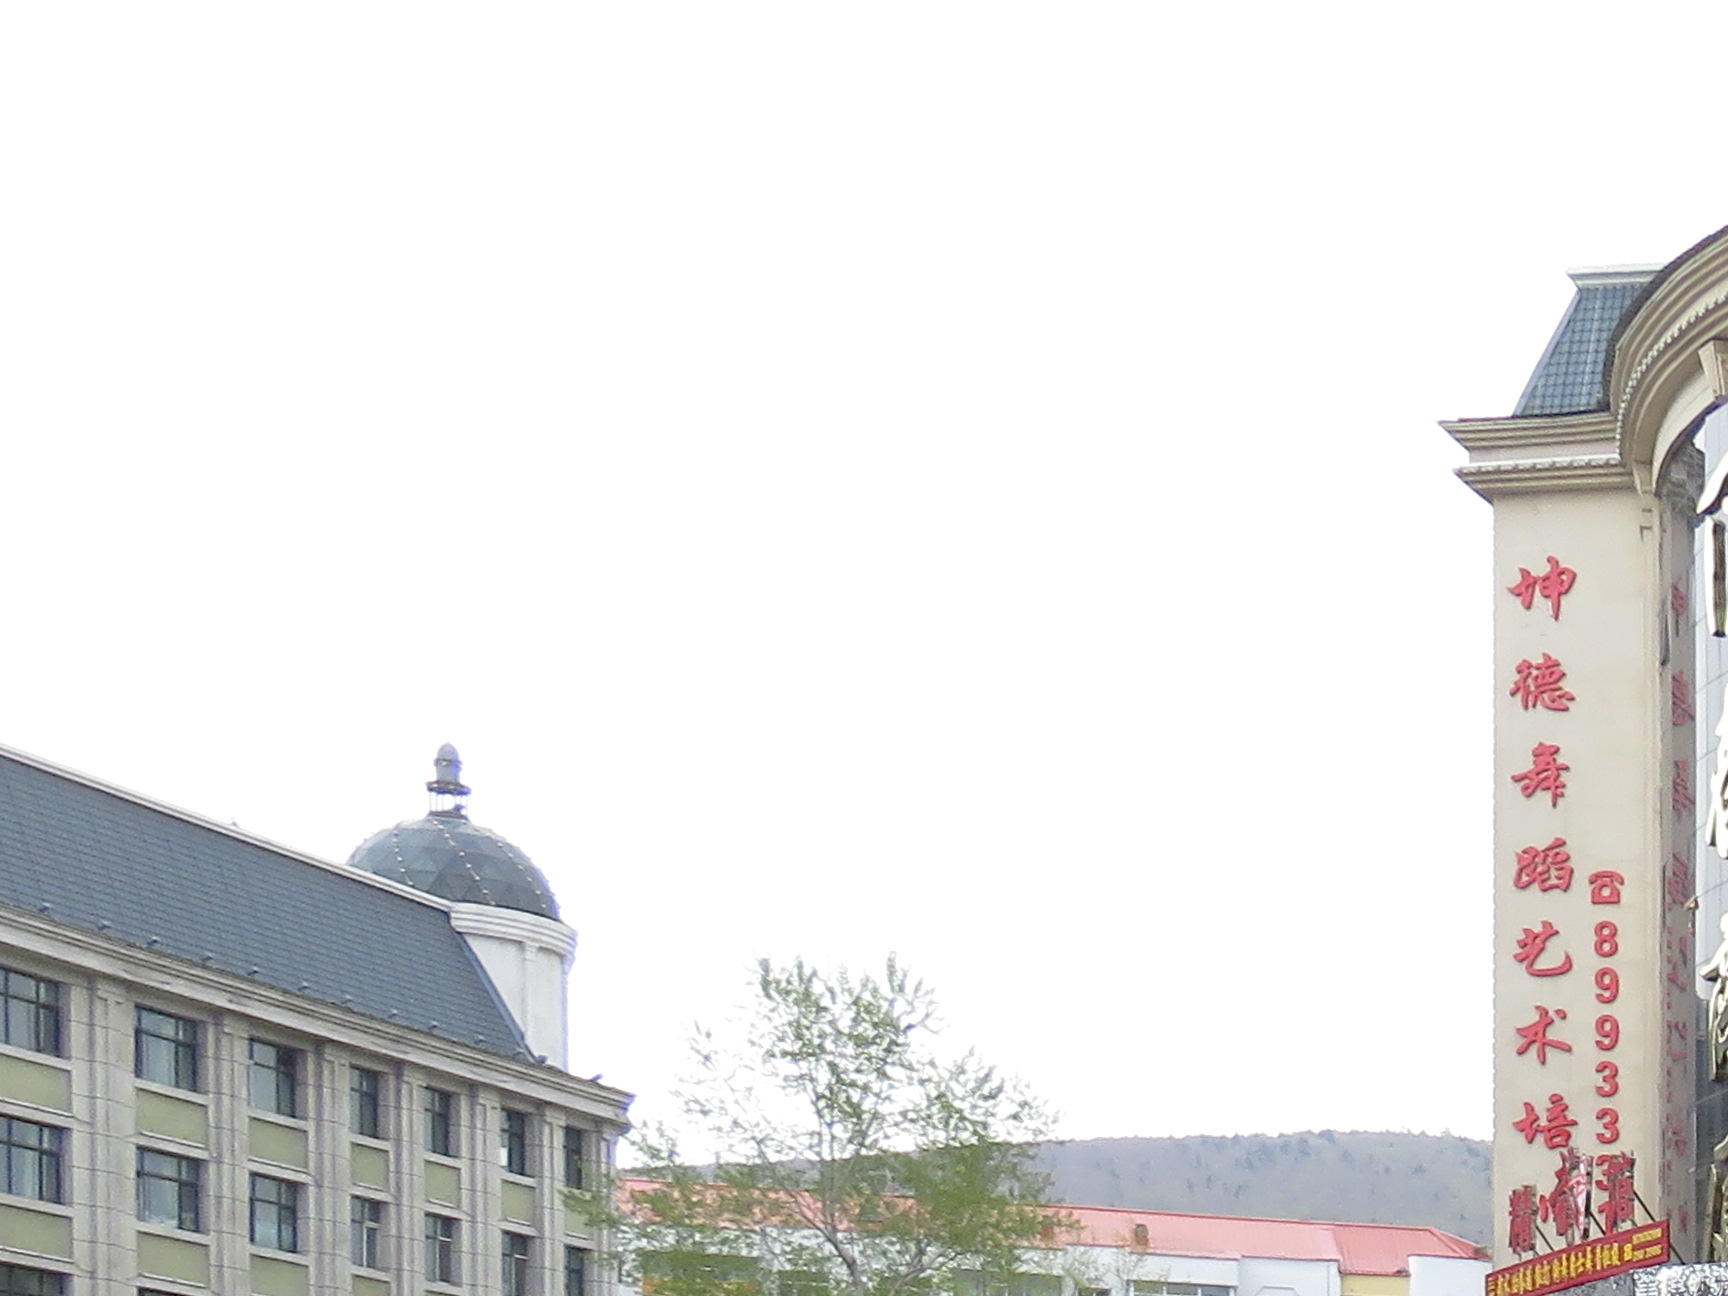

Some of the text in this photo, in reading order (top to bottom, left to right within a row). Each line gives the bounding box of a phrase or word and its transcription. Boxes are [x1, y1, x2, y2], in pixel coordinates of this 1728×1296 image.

[1507, 555, 1577, 1222] 坤德舞蹈艺术培
